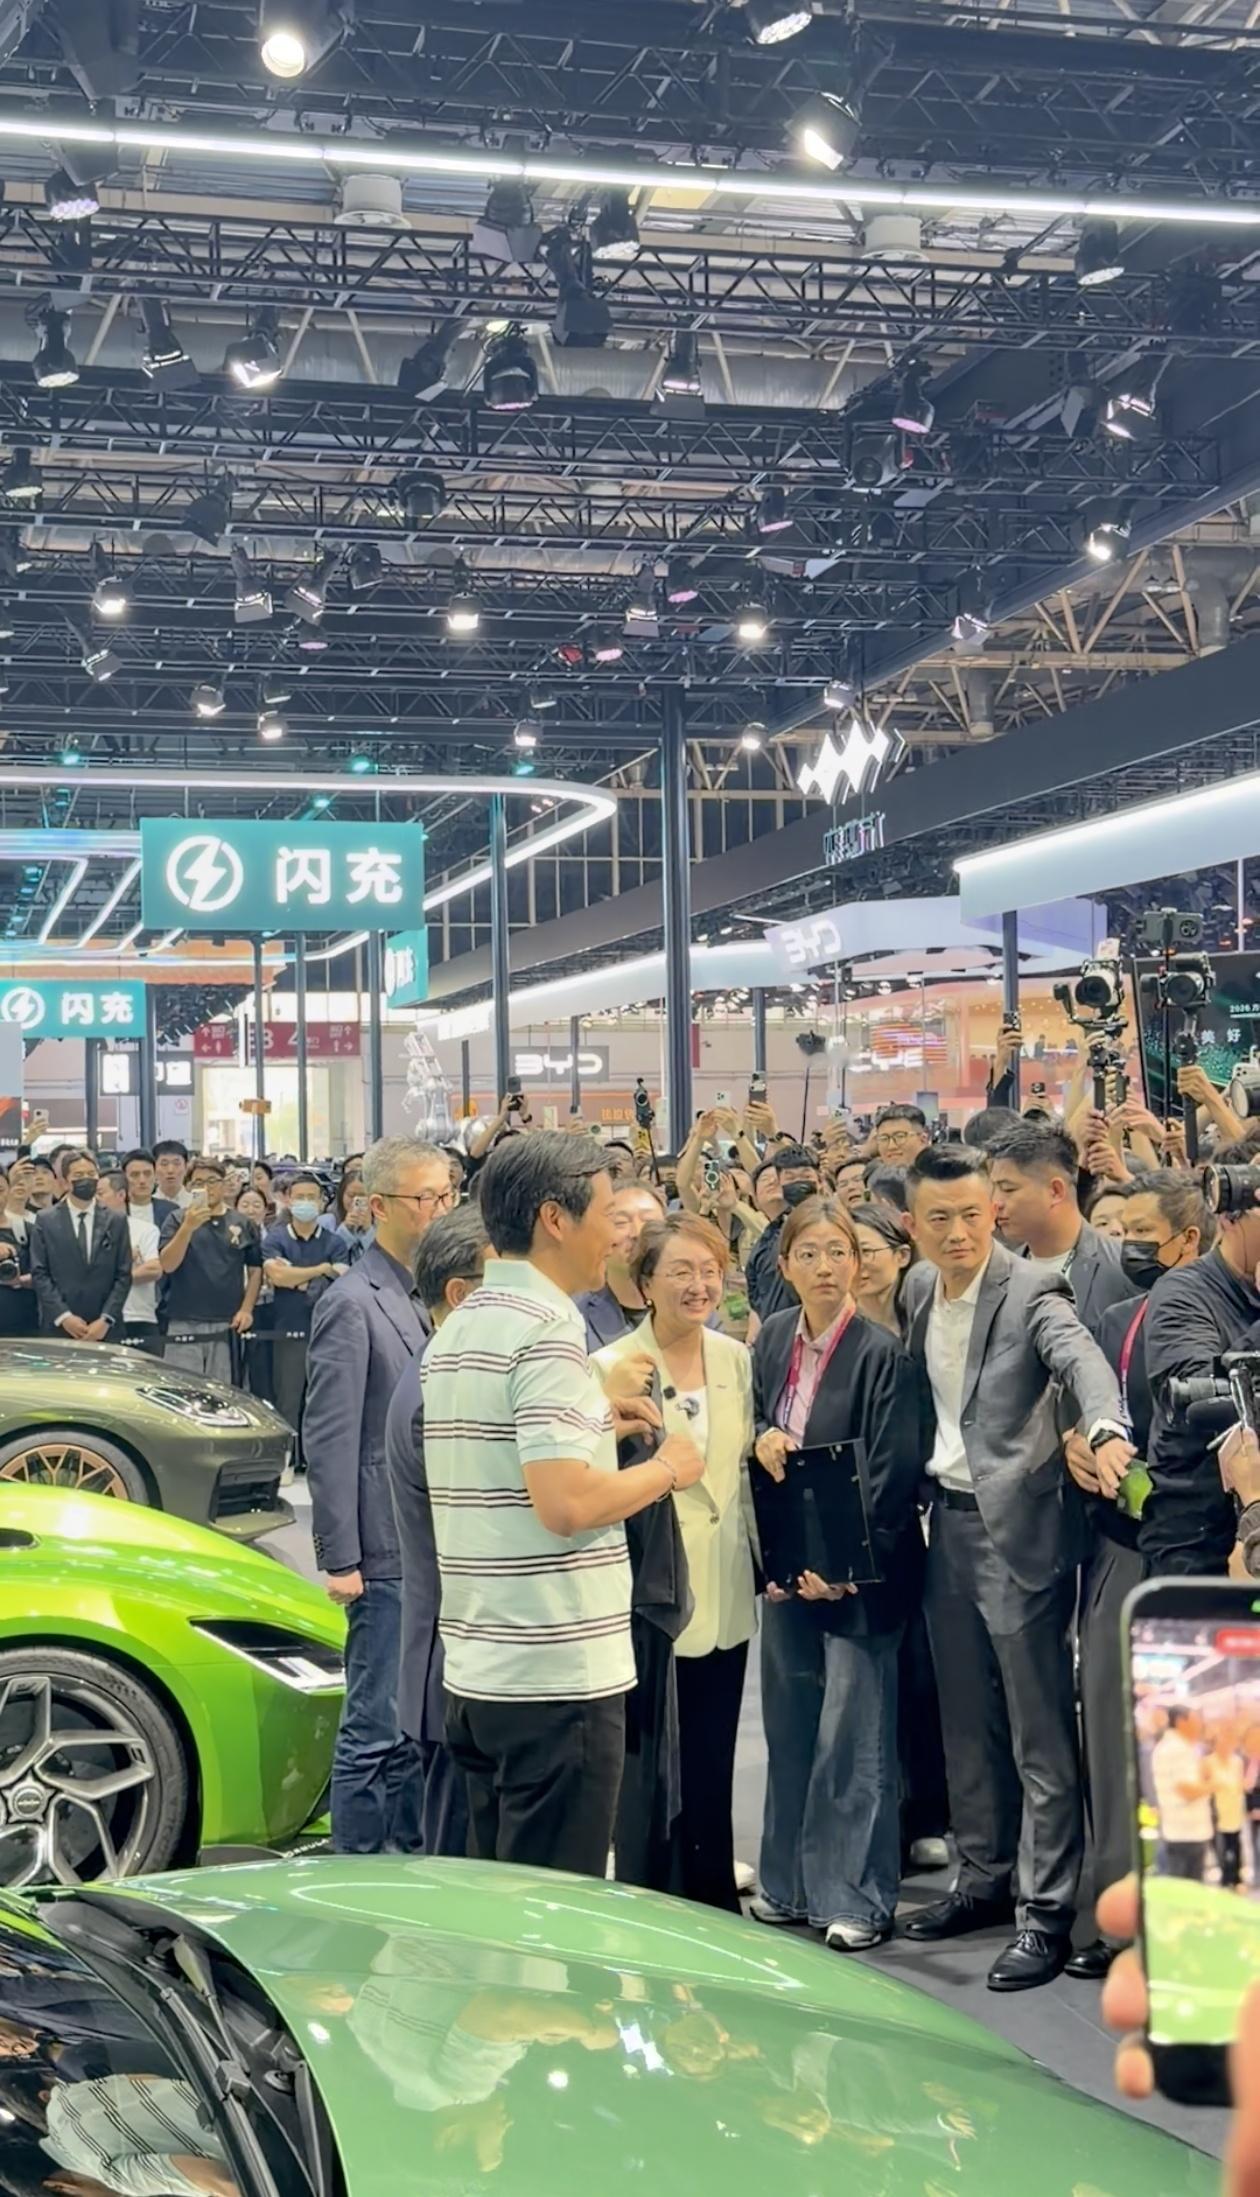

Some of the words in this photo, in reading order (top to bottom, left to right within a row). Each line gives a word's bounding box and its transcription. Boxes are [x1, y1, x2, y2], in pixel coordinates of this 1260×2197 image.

[276, 846, 403, 904] 闪充
[61, 991, 135, 1025] 闪充
[514, 1053, 603, 1075] BYD
